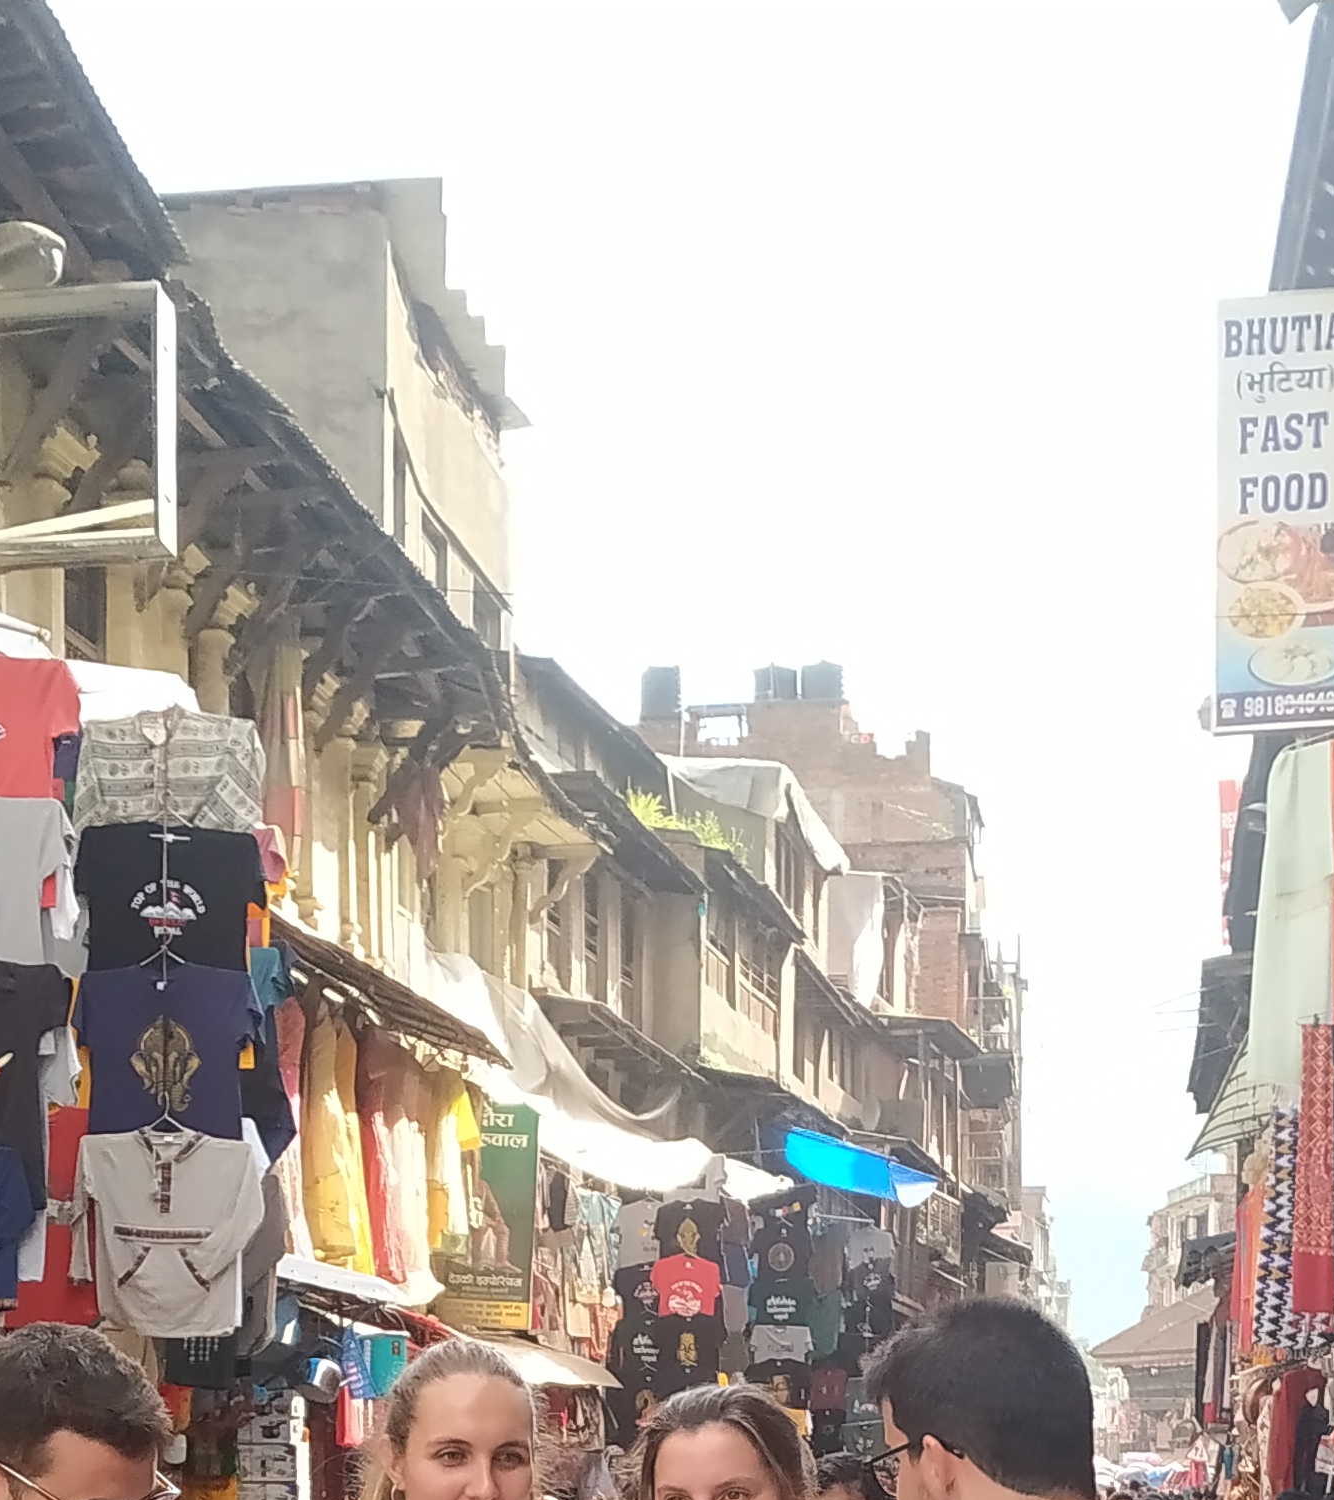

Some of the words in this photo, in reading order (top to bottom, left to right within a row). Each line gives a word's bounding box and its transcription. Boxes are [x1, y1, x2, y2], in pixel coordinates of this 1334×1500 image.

[1236, 361, 1334, 403] (भुटिया)
[1239, 410, 1329, 454] FAST
[1239, 472, 1329, 515] FOOD
